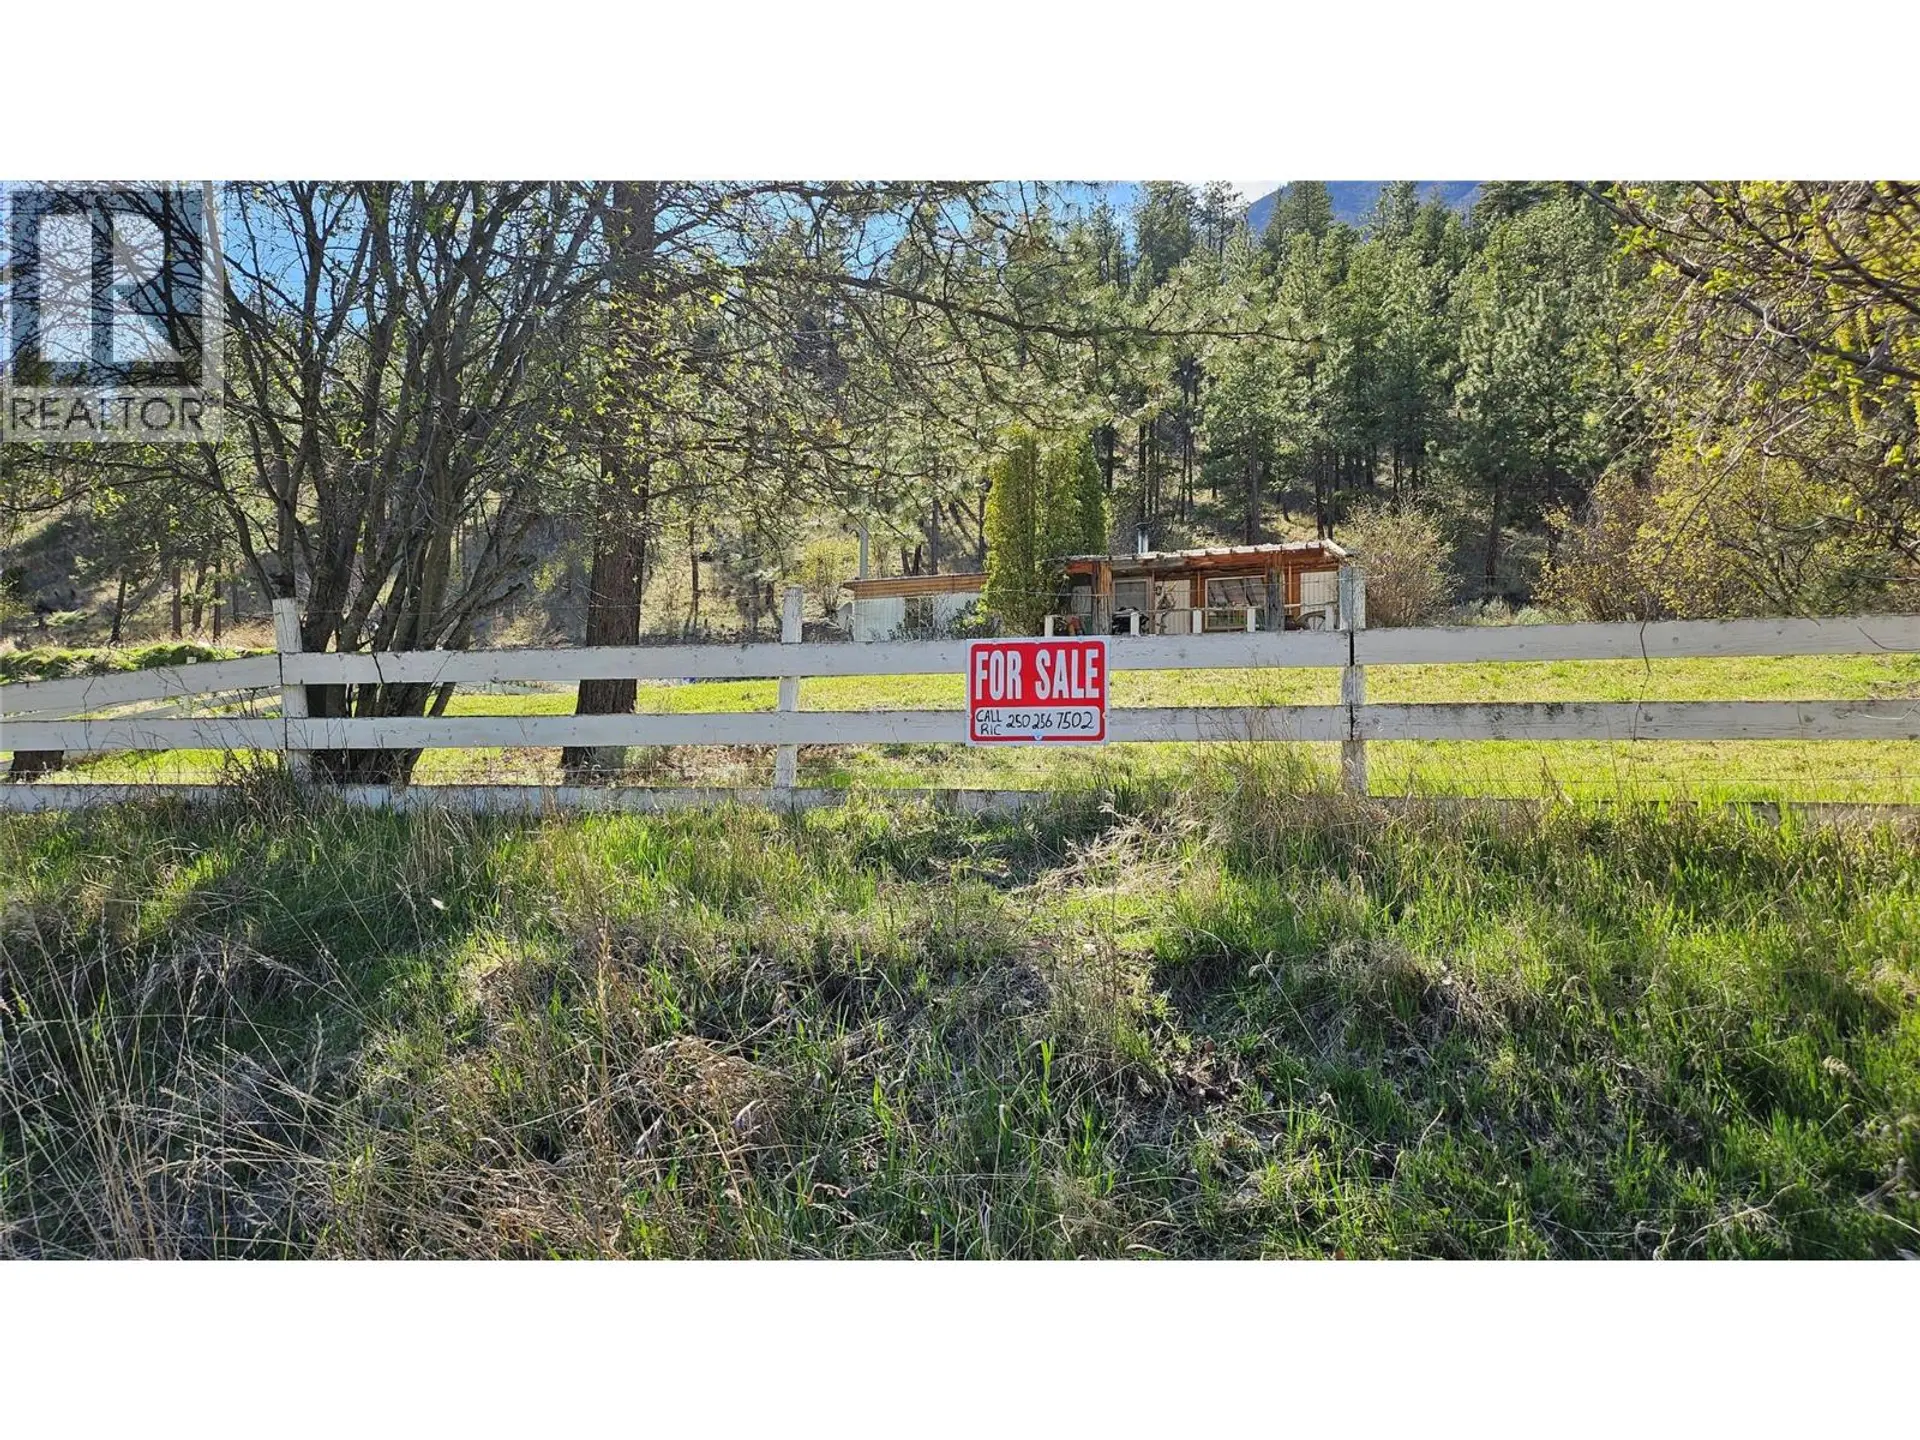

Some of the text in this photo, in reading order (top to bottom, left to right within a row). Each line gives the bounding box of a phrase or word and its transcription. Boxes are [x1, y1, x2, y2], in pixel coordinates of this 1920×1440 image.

[975, 648, 1100, 700] FOR SALE
[976, 709, 1002, 723] CALL
[1006, 711, 1095, 730] 250 256 7502
[980, 723, 1002, 736] RIC
